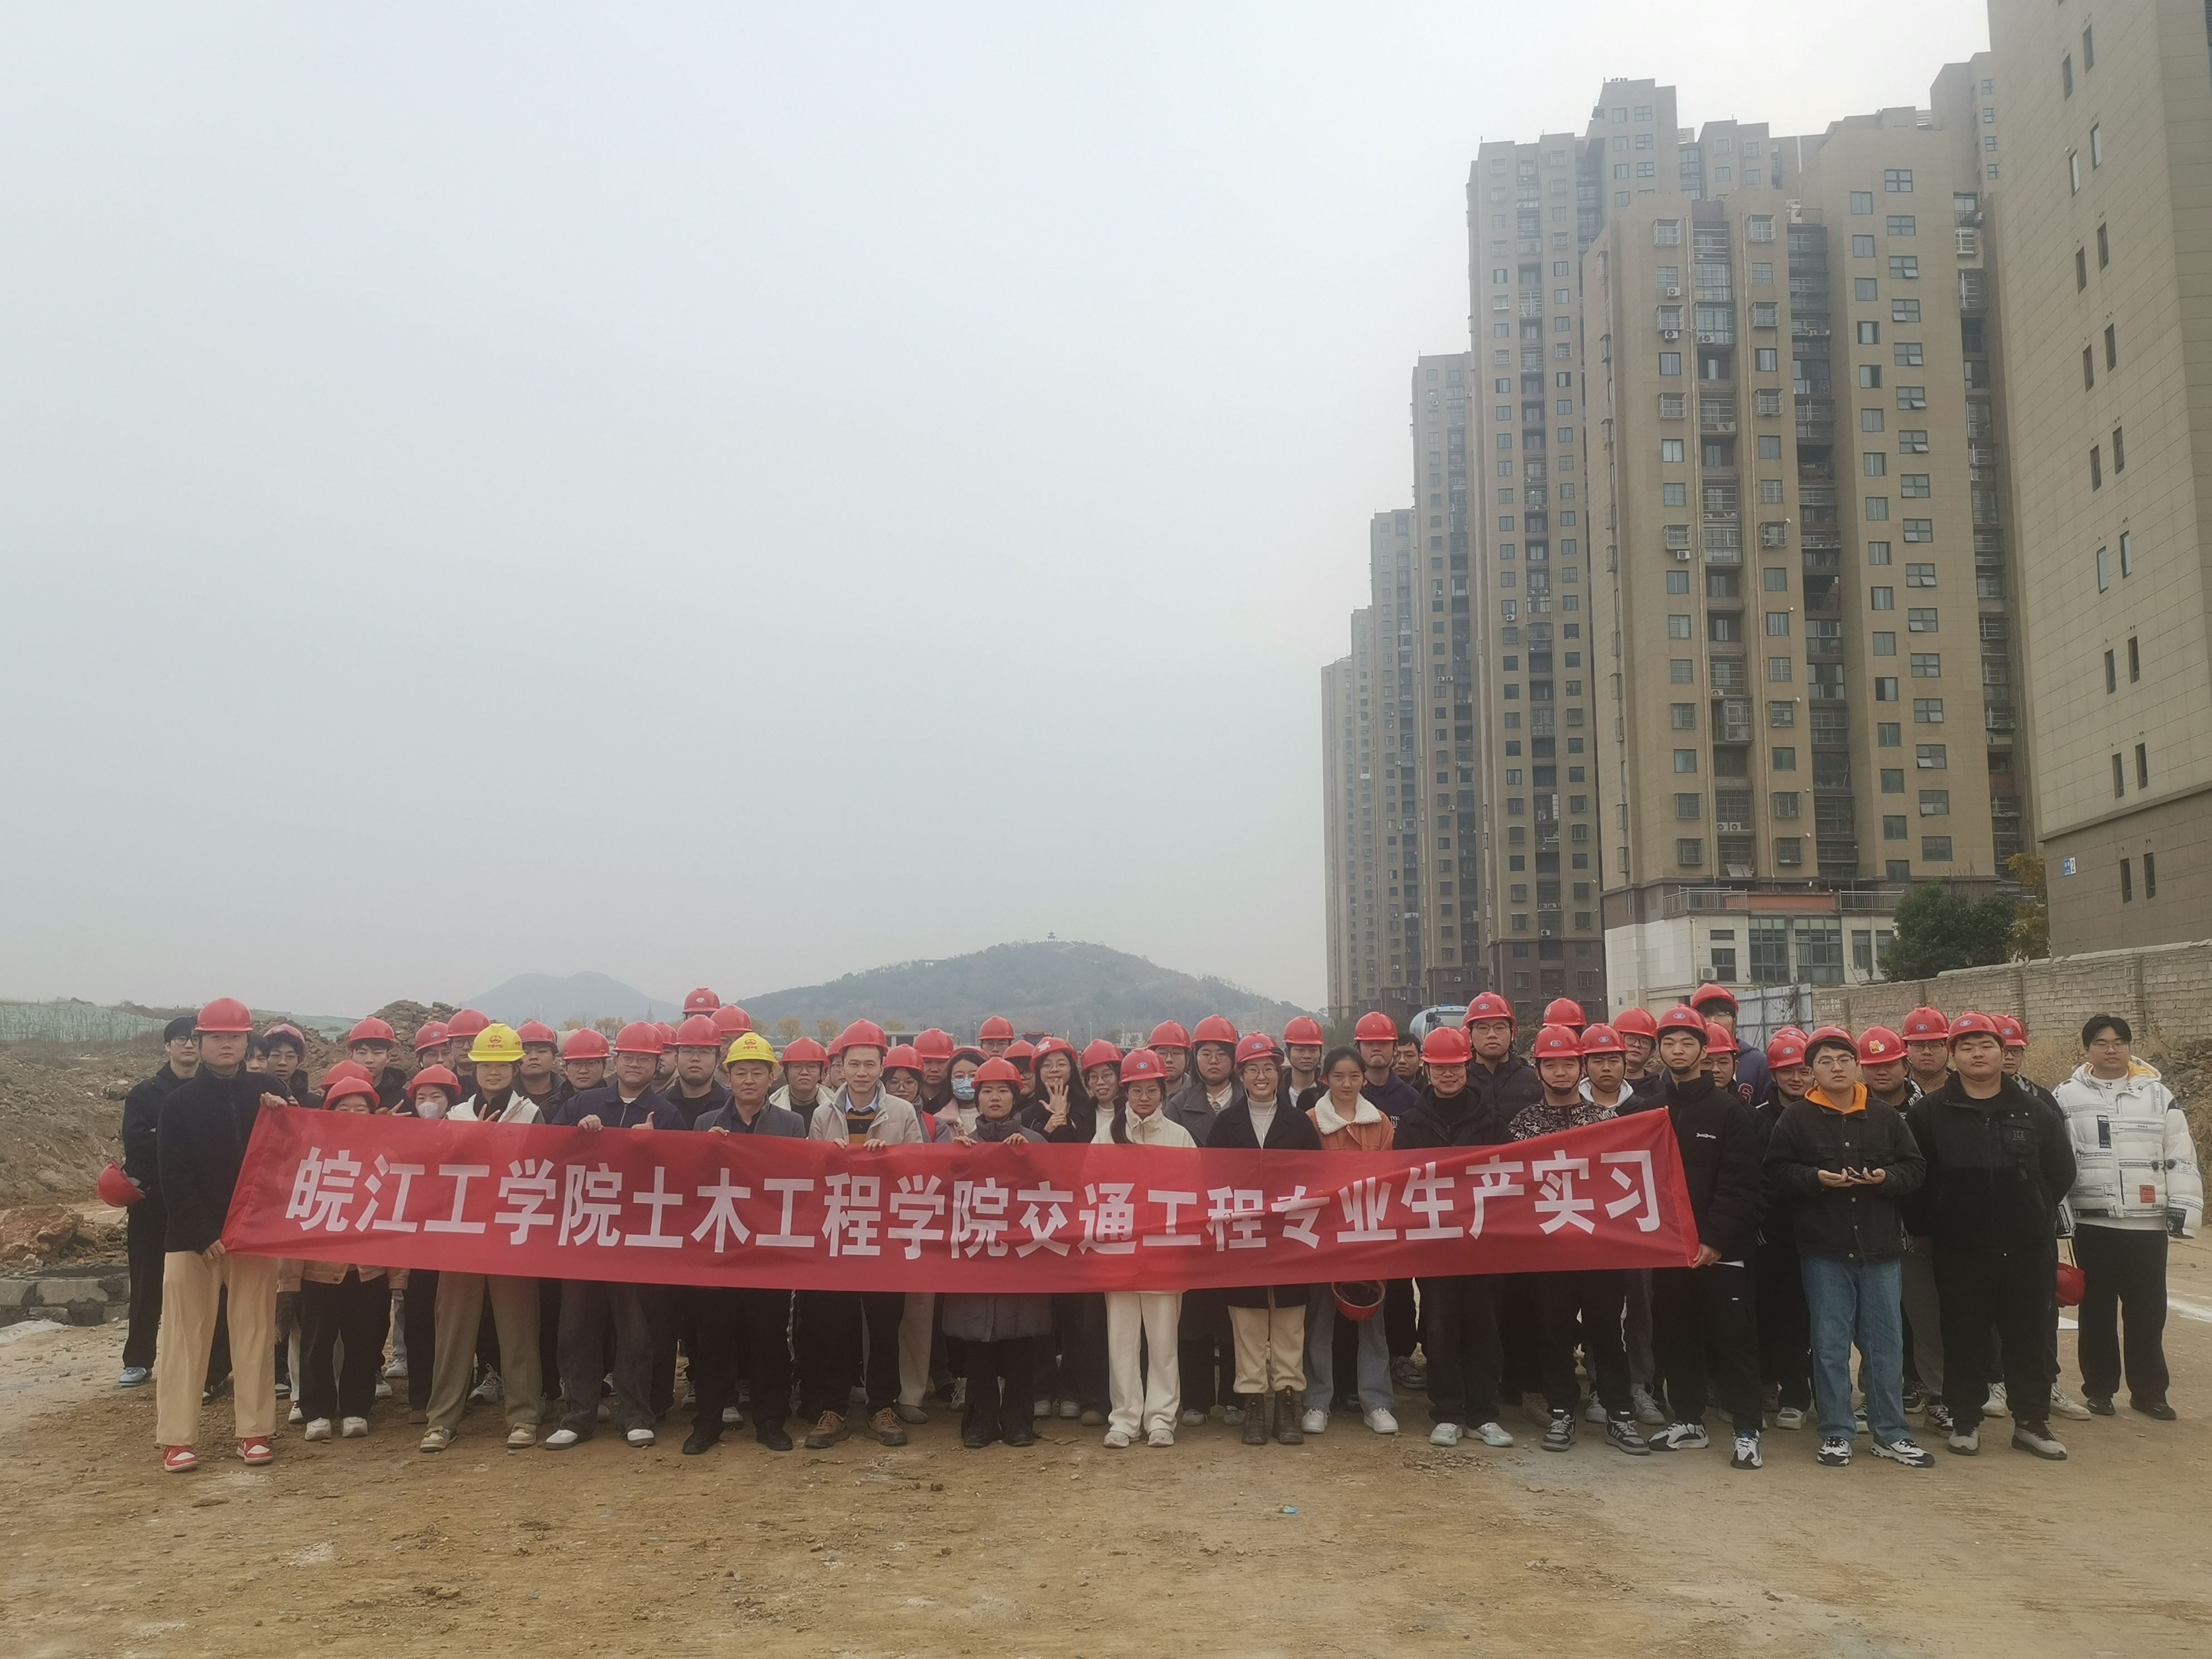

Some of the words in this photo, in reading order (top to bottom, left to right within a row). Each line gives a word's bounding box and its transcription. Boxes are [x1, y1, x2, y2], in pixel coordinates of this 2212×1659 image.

[2071, 859, 2075, 872] 2
[1738, 1083, 1754, 1104] S
[285, 1146, 1661, 1260] 皖江工学院土木工程学院交通工程专业生产实习
